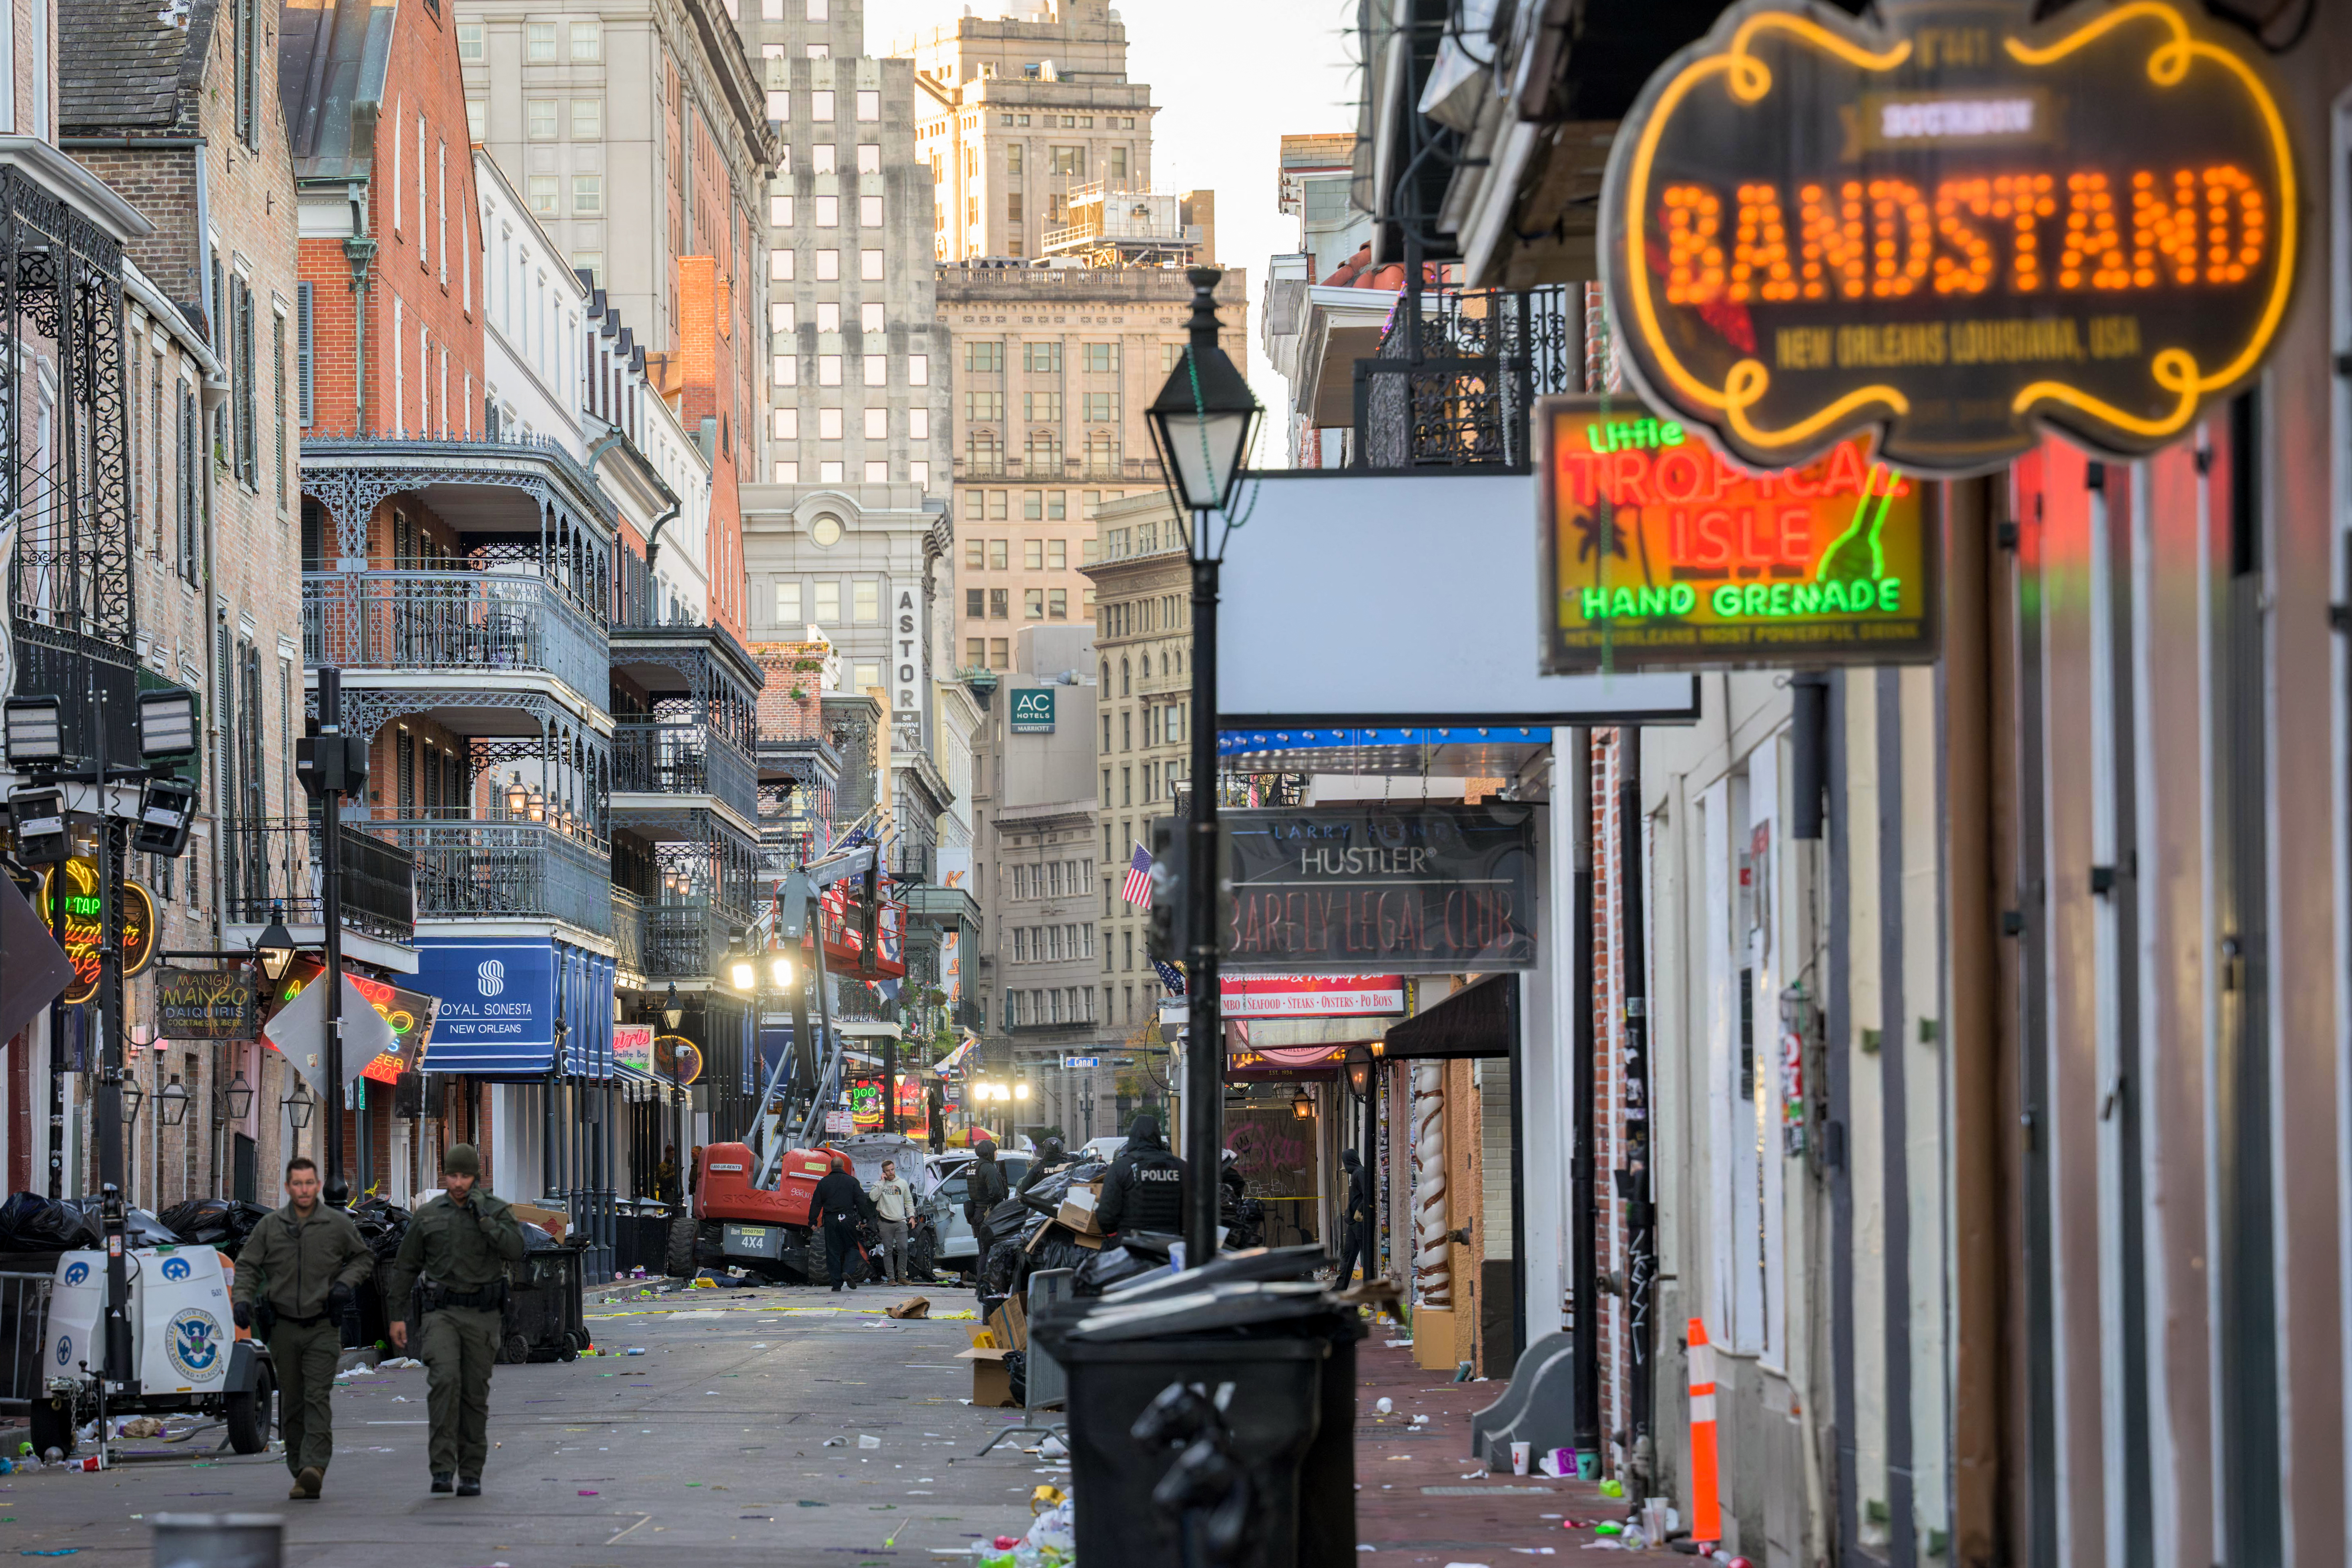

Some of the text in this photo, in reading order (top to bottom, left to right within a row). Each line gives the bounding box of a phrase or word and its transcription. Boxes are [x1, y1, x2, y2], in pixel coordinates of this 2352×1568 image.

[1663, 165, 2264, 305] BANDSTAND
[1776, 327, 1831, 369] NEW
[1837, 323, 1945, 367] ORLEANS
[2089, 316, 2141, 357] USA
[1674, 508, 1811, 564] ISLE
[1582, 577, 1901, 619] HAND GRENADE
[899, 591, 914, 707] ASTOR
[1017, 694, 1049, 711] AC
[1274, 825, 1350, 839] LARRY
[73, 897, 101, 914] TAP
[1345, 890, 1435, 952] LEGAL
[1444, 889, 1514, 951] CLUB
[177, 974, 234, 986] MANGO
[163, 987, 249, 1007] MANGO
[1221, 999, 1240, 1011] UMBO
[1247, 997, 1280, 1010] SEAFOOD
[1287, 996, 1314, 1009] STEAKS
[1322, 995, 1354, 1008] OYSTERS
[1373, 994, 1393, 1007] BOYS
[166, 1007, 245, 1019] DAIQUIRIS
[438, 1003, 532, 1015] OYAL SONESTA
[450, 1024, 521, 1034] NEW ORLEANS
[373, 1053, 404, 1070] EER
[637, 1050, 649, 1058] Bar
[1075, 1058, 1093, 1067] Canal
[853, 1087, 875, 1099] DOO
[1141, 1169, 1180, 1181] POLICE
[741, 1236, 763, 1249] 4X4
